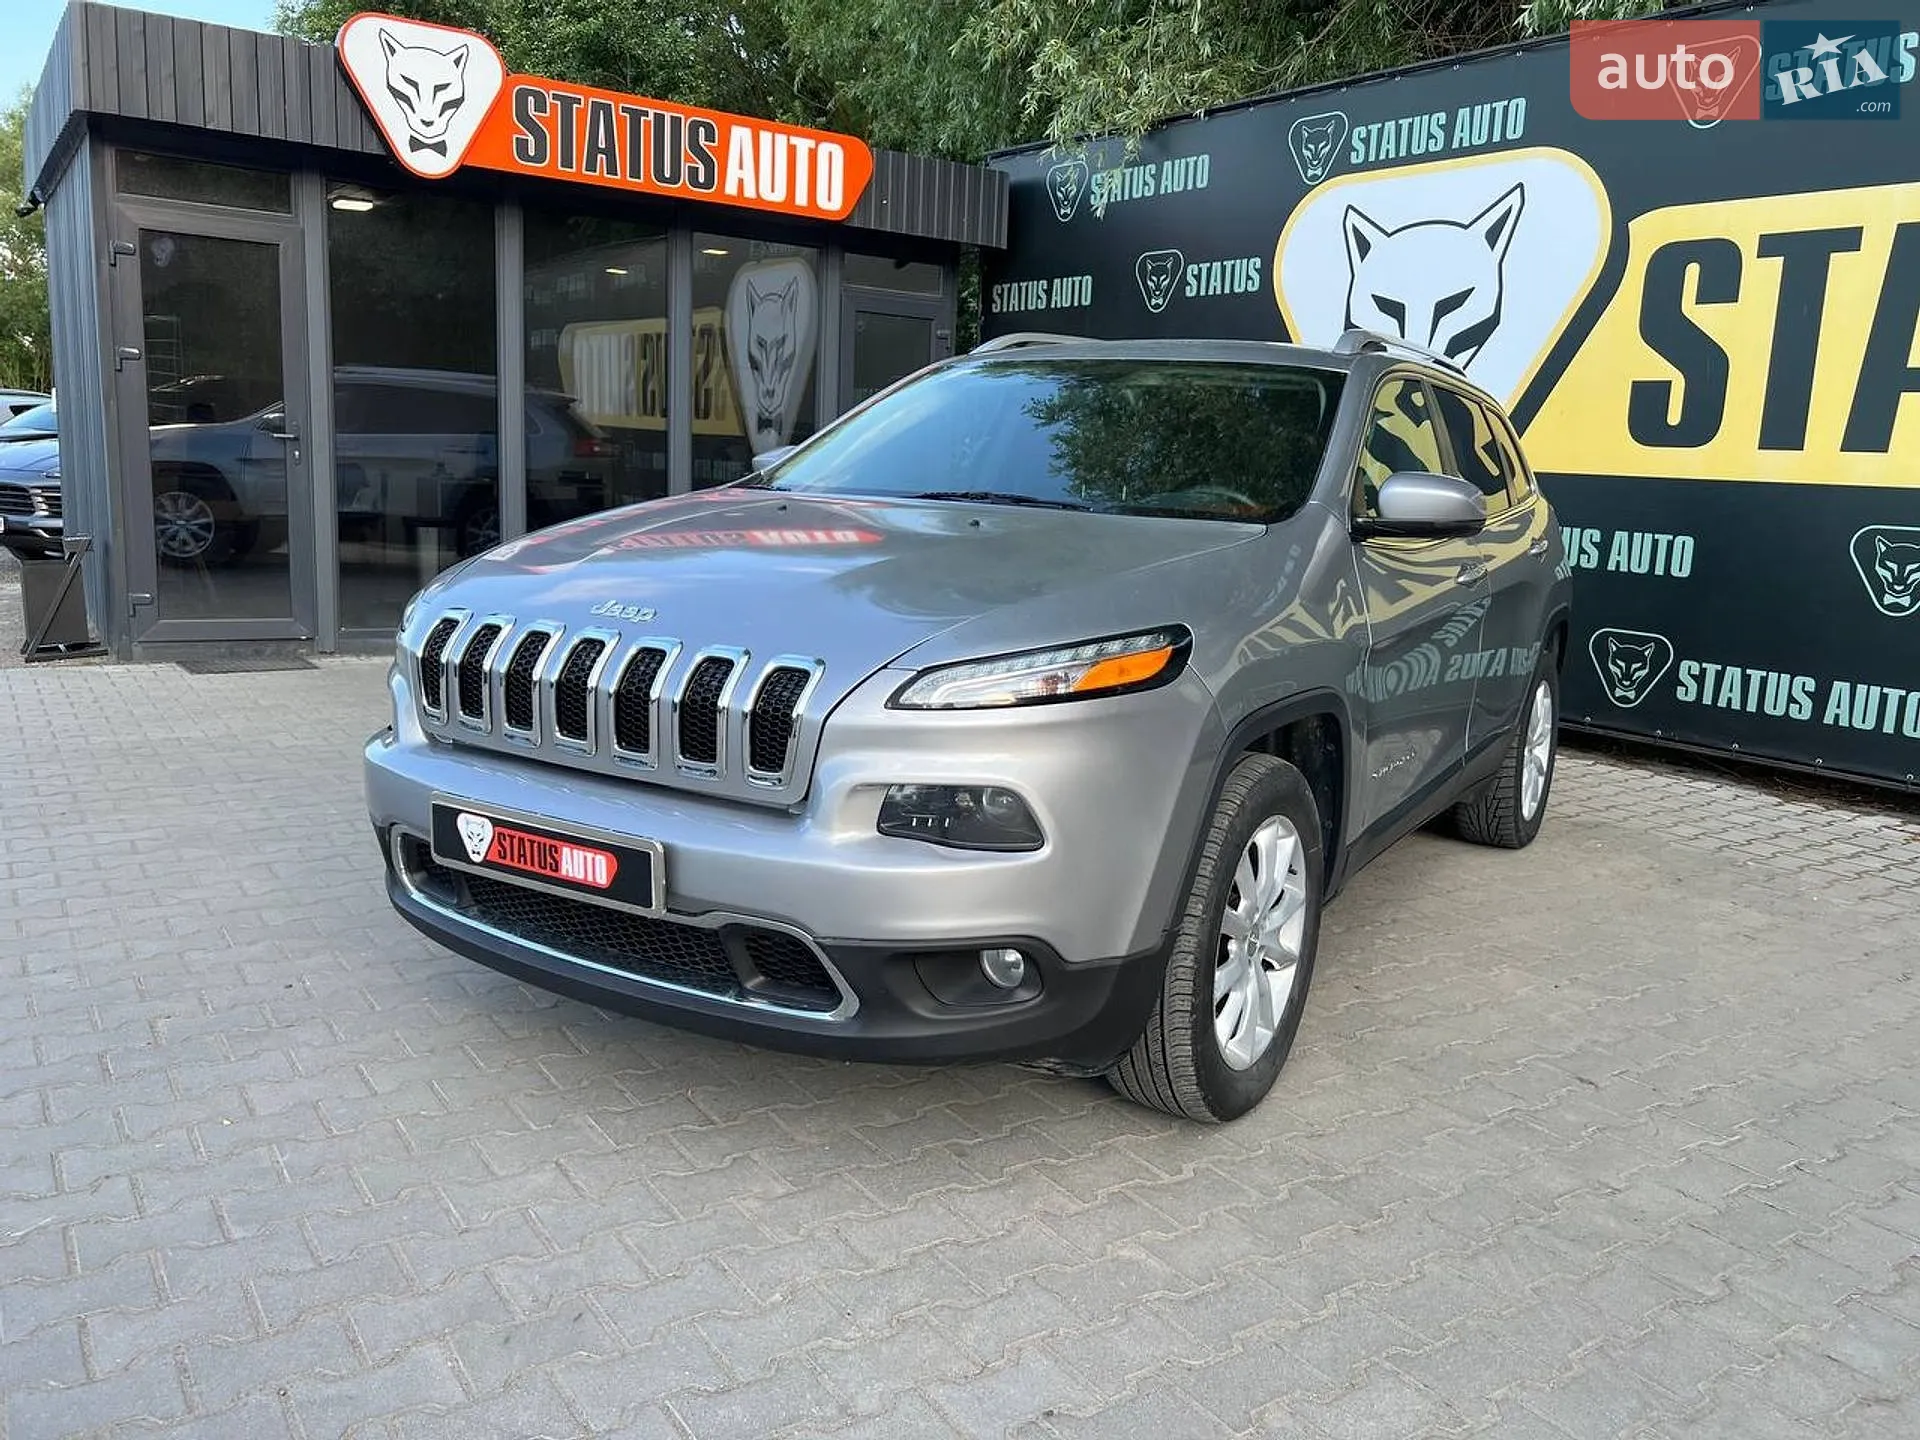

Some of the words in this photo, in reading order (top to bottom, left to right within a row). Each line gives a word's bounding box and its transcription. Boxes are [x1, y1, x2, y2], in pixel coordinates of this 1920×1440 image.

[511, 86, 718, 193] STATUS
[724, 125, 844, 211] AUTO
[1350, 112, 1447, 164] STATUS
[1452, 97, 1527, 149] AUTO
[1159, 154, 1210, 195] AUTO
[991, 279, 1049, 314] STATUS
[1050, 275, 1093, 309] AUTO
[1184, 257, 1262, 298] STATUS
[1606, 530, 1695, 578] AUTO
[589, 599, 658, 623] Jeep
[1675, 659, 1817, 721] STATUS
[1823, 680, 1920, 739] AUTO
[497, 830, 560, 873] STATUS
[561, 847, 607, 886] AUTO
